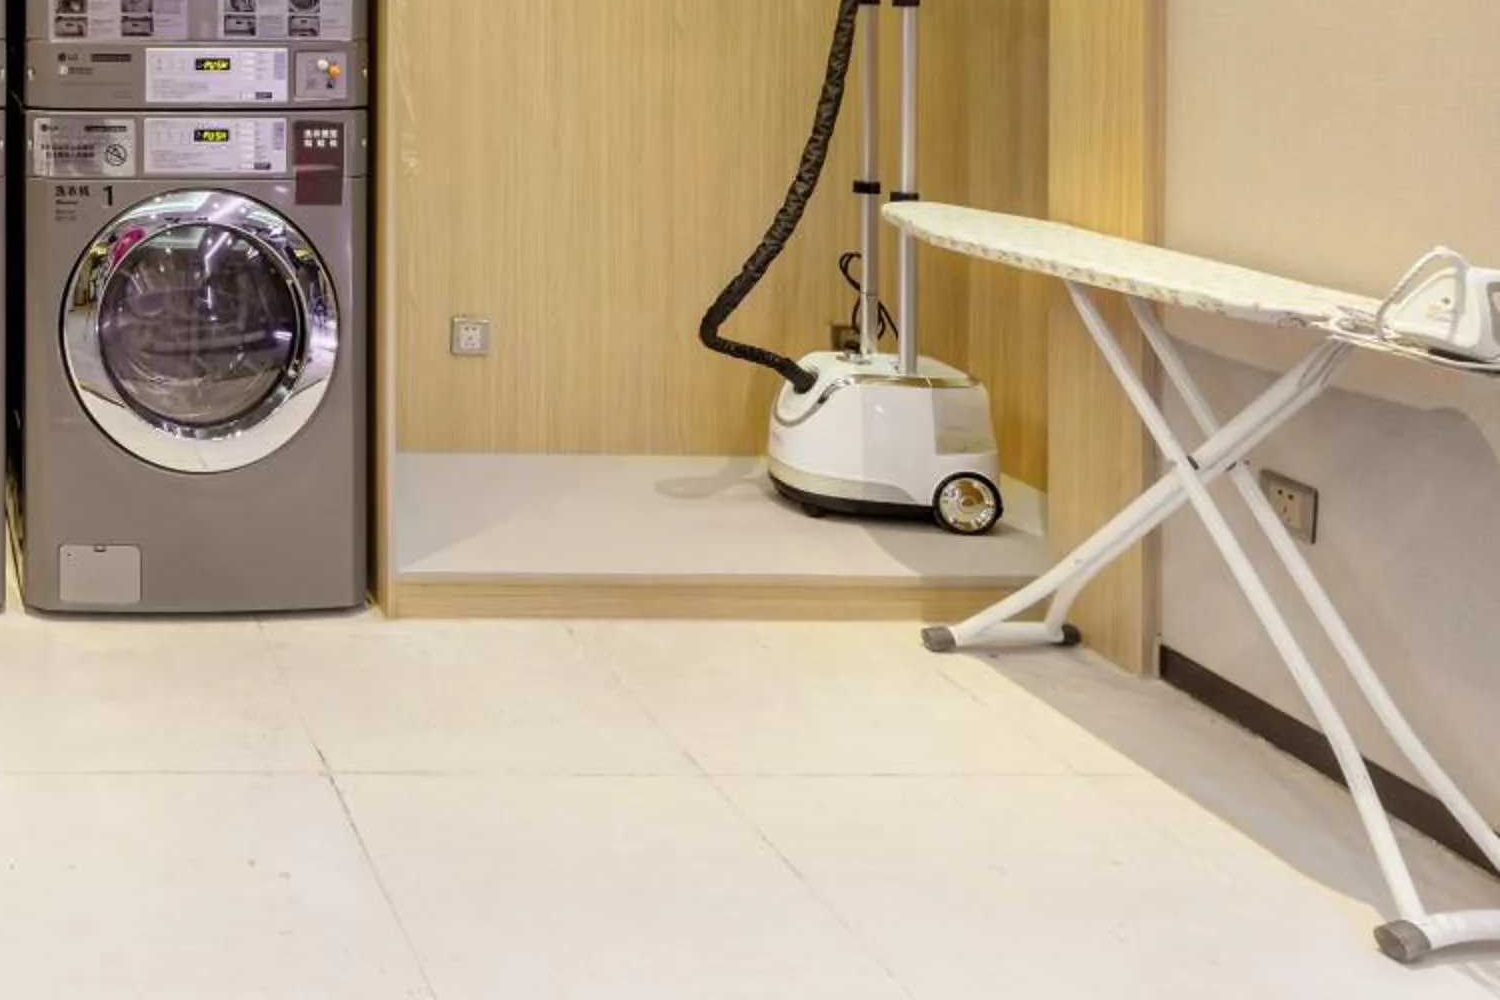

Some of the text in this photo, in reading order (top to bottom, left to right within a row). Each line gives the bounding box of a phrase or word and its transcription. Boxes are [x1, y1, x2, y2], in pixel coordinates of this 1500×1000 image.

[54, 184, 114, 207] 洗衣机 1
